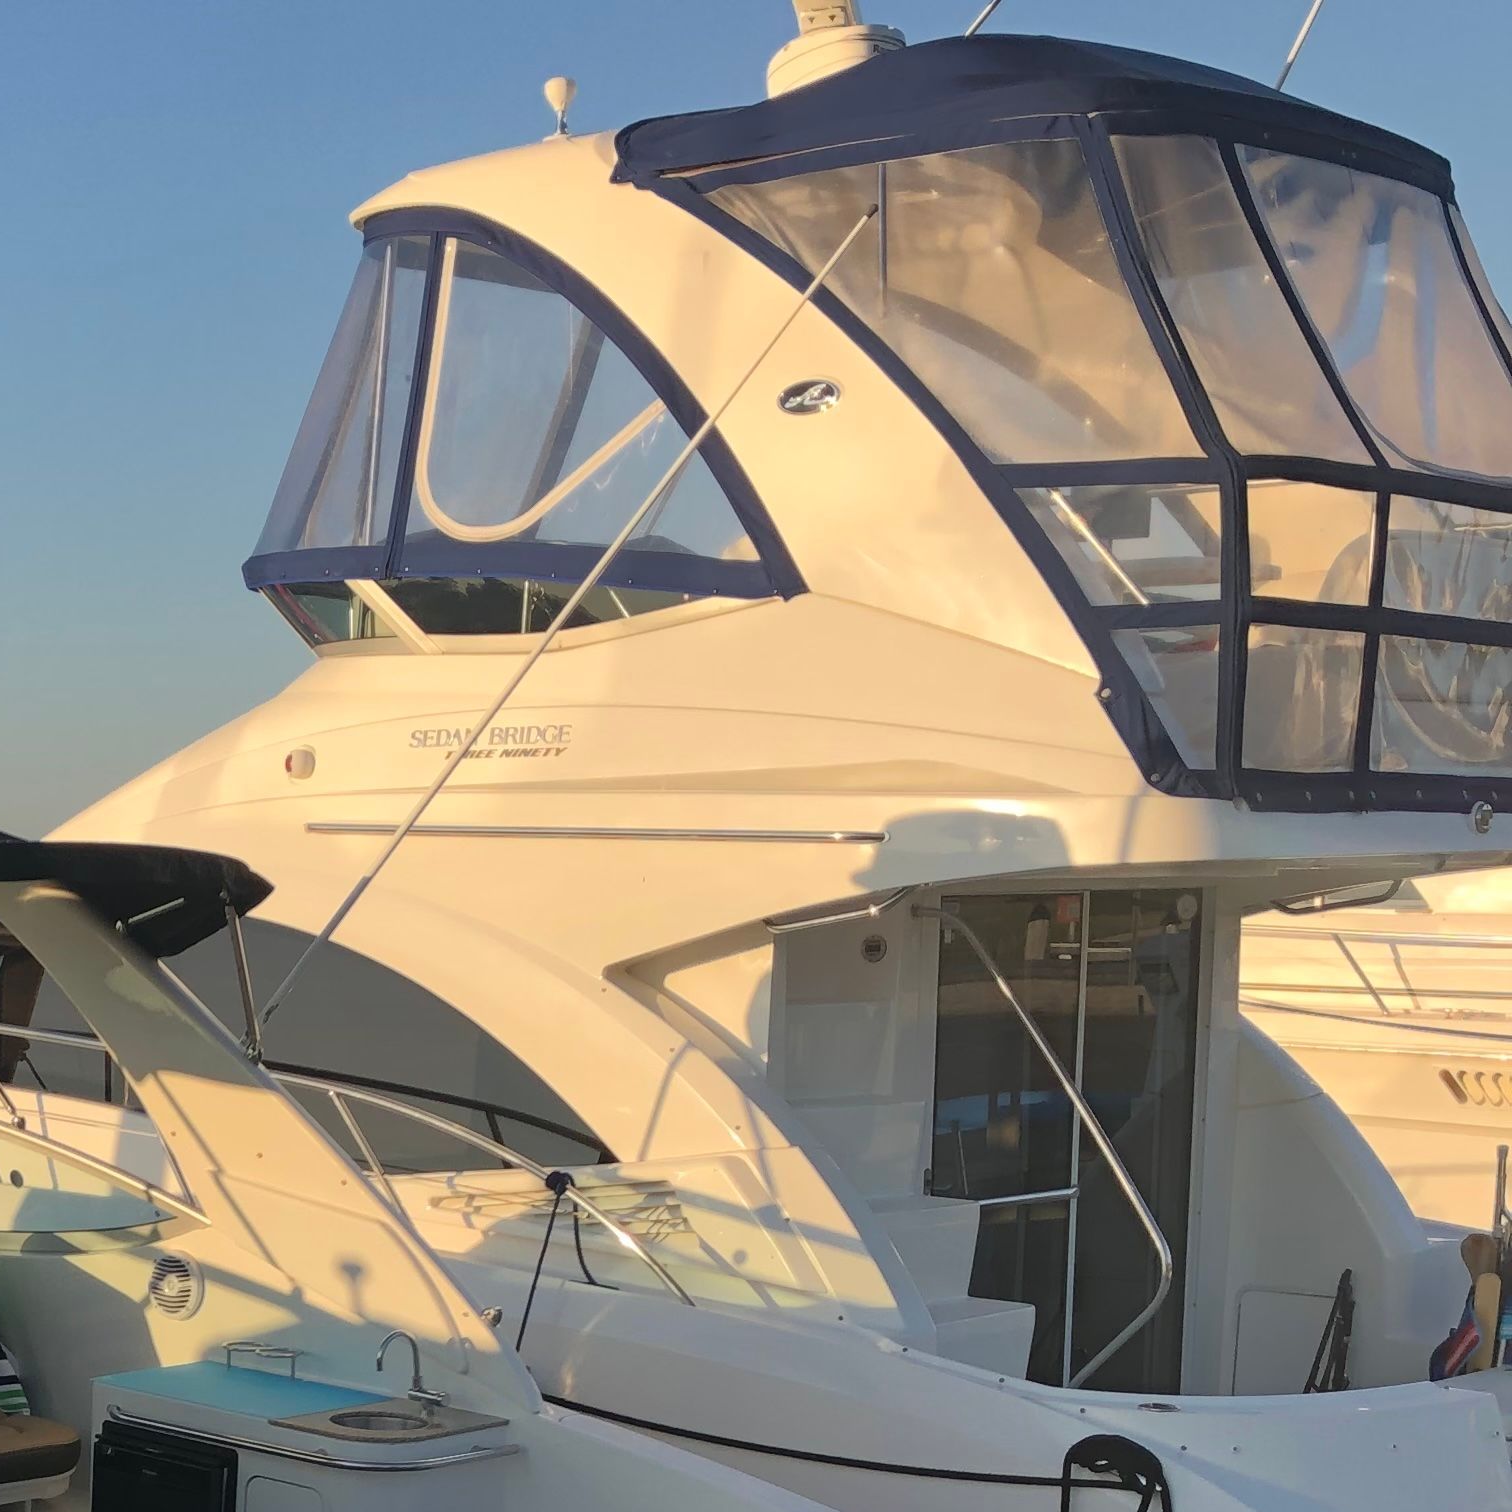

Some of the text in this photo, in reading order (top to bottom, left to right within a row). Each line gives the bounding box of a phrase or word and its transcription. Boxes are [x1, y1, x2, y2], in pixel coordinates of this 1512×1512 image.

[488, 724, 573, 746] BRIDGE
[444, 747, 568, 761] TREE NINETY
